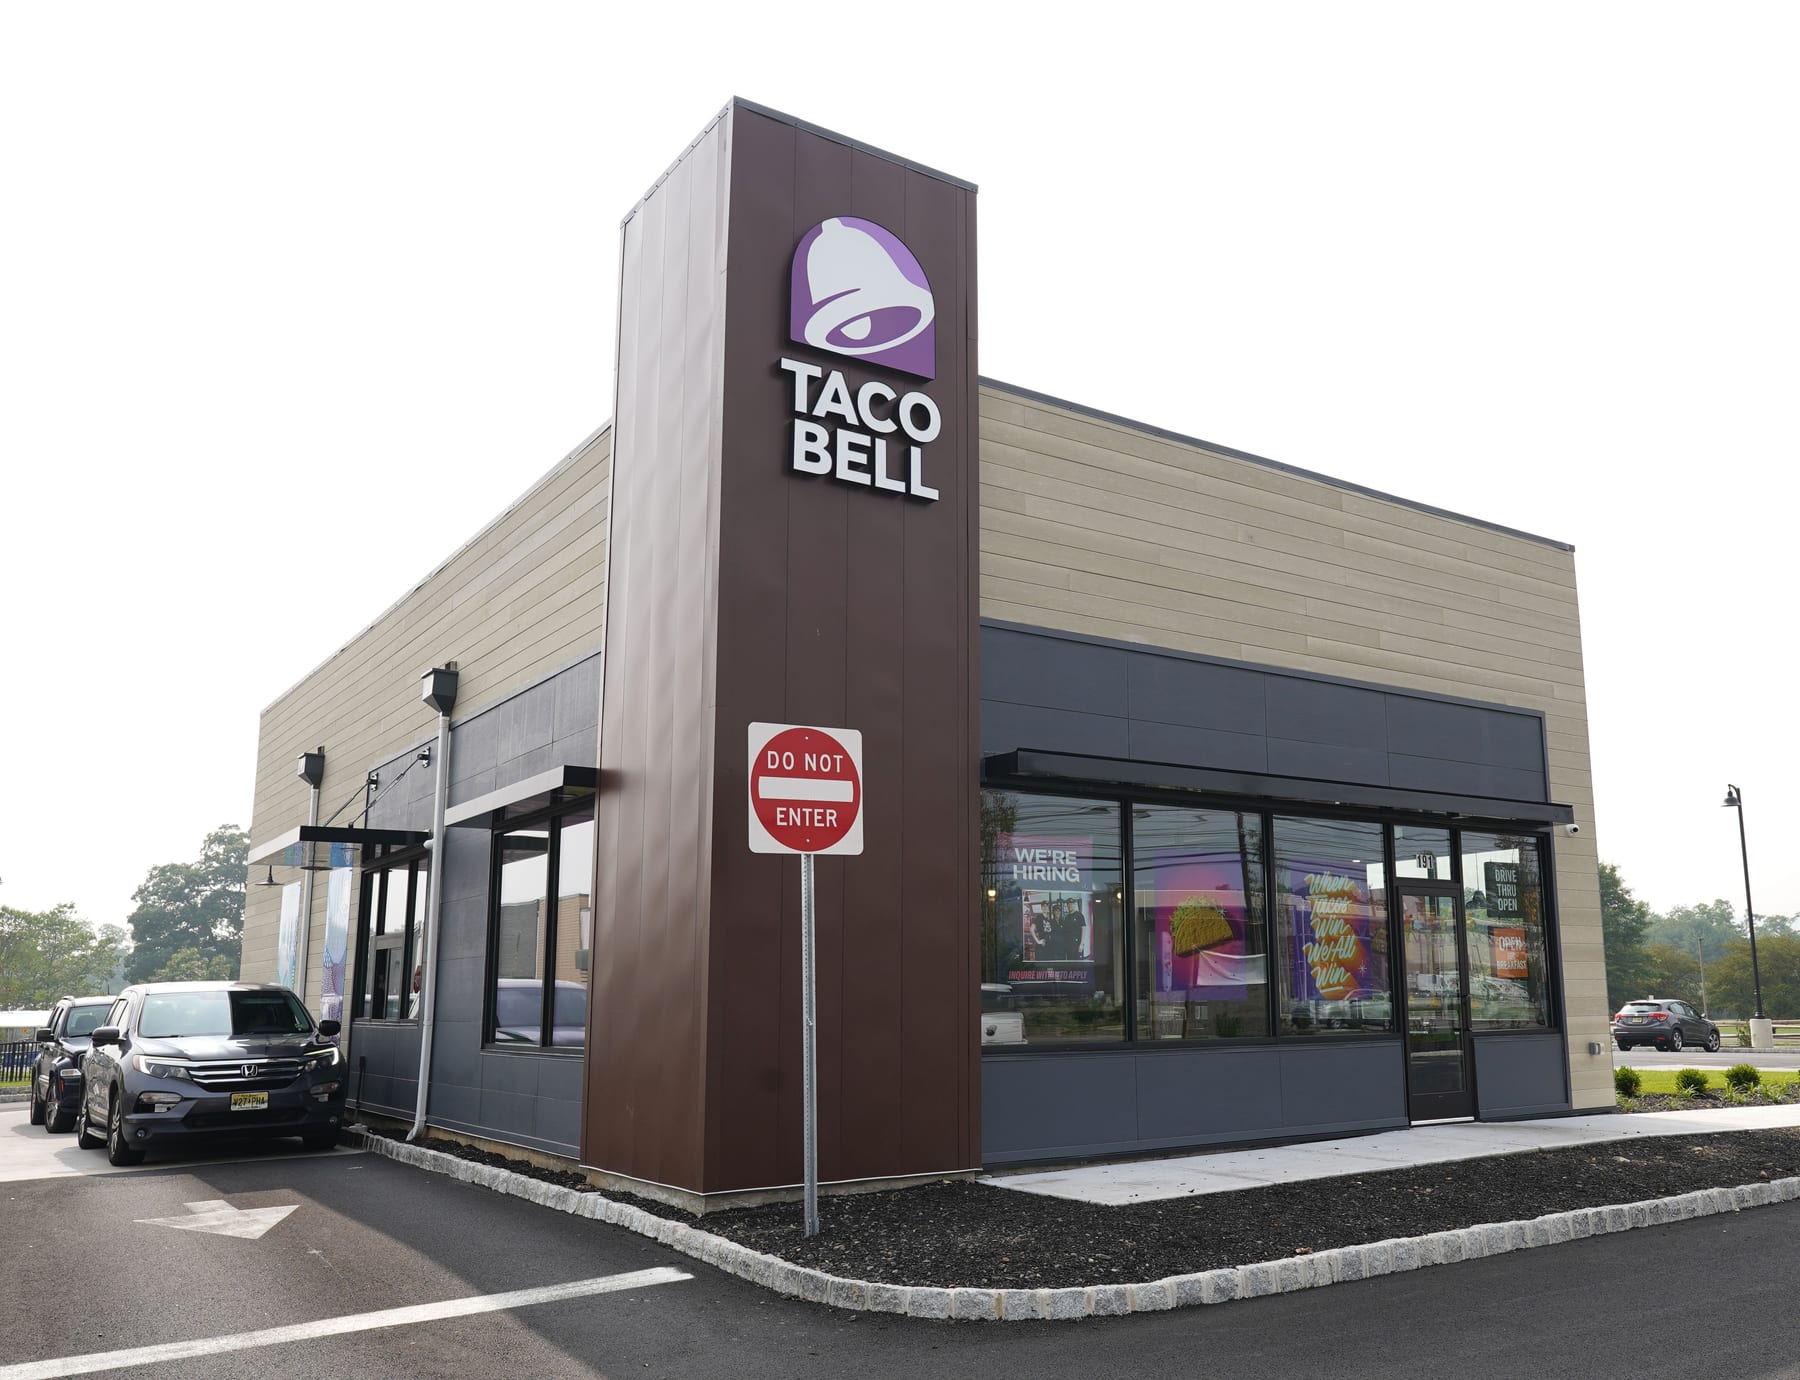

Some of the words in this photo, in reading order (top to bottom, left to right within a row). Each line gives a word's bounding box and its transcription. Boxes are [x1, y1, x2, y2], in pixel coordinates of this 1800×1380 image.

[780, 357, 941, 443] TACO
[793, 418, 939, 501] BELL
[767, 750, 795, 770] DO
[804, 753, 843, 773] NOT
[776, 807, 837, 828] ENTER
[1014, 847, 1077, 865] WE'RE
[1417, 855, 1432, 869] 191
[1013, 864, 1080, 882] HIRING
[1495, 869, 1517, 882] DRIVE
[1304, 871, 1354, 895] When
[1496, 883, 1517, 897] THRU
[1497, 898, 1518, 911] OPEN
[1310, 915, 1351, 940] Win
[1008, 970, 1036, 980] INQUIRE
[1069, 970, 1088, 979] APPLY
[1310, 962, 1351, 988] Win
